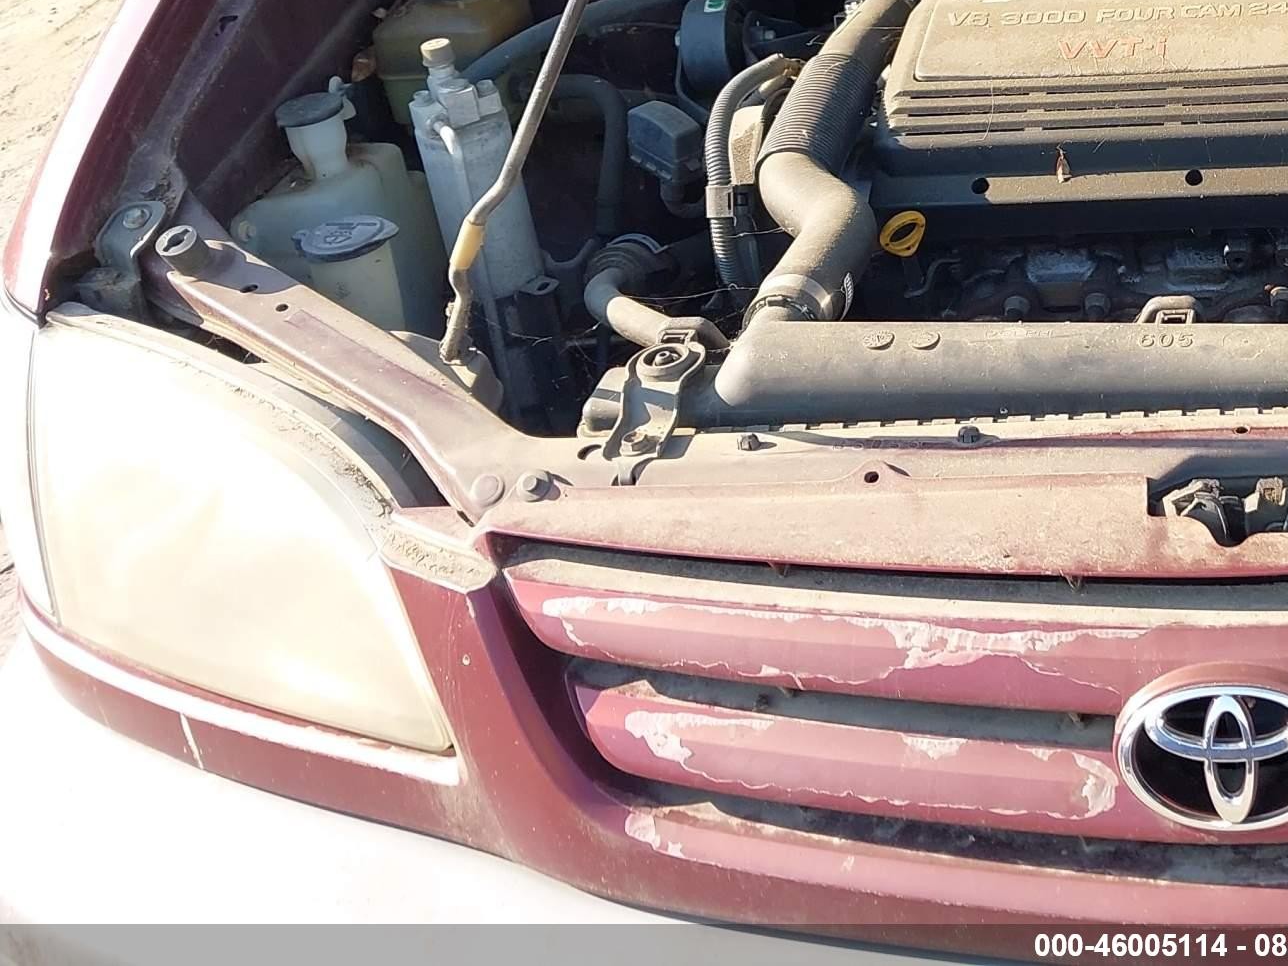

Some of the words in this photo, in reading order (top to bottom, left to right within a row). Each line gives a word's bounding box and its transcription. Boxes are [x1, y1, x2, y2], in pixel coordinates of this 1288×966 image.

[949, 10, 990, 27] V6
[1000, 9, 1087, 26] 3000
[1095, 5, 1175, 23] FOUR
[1180, 3, 1243, 19] CAM
[1139, 332, 1195, 349] 605
